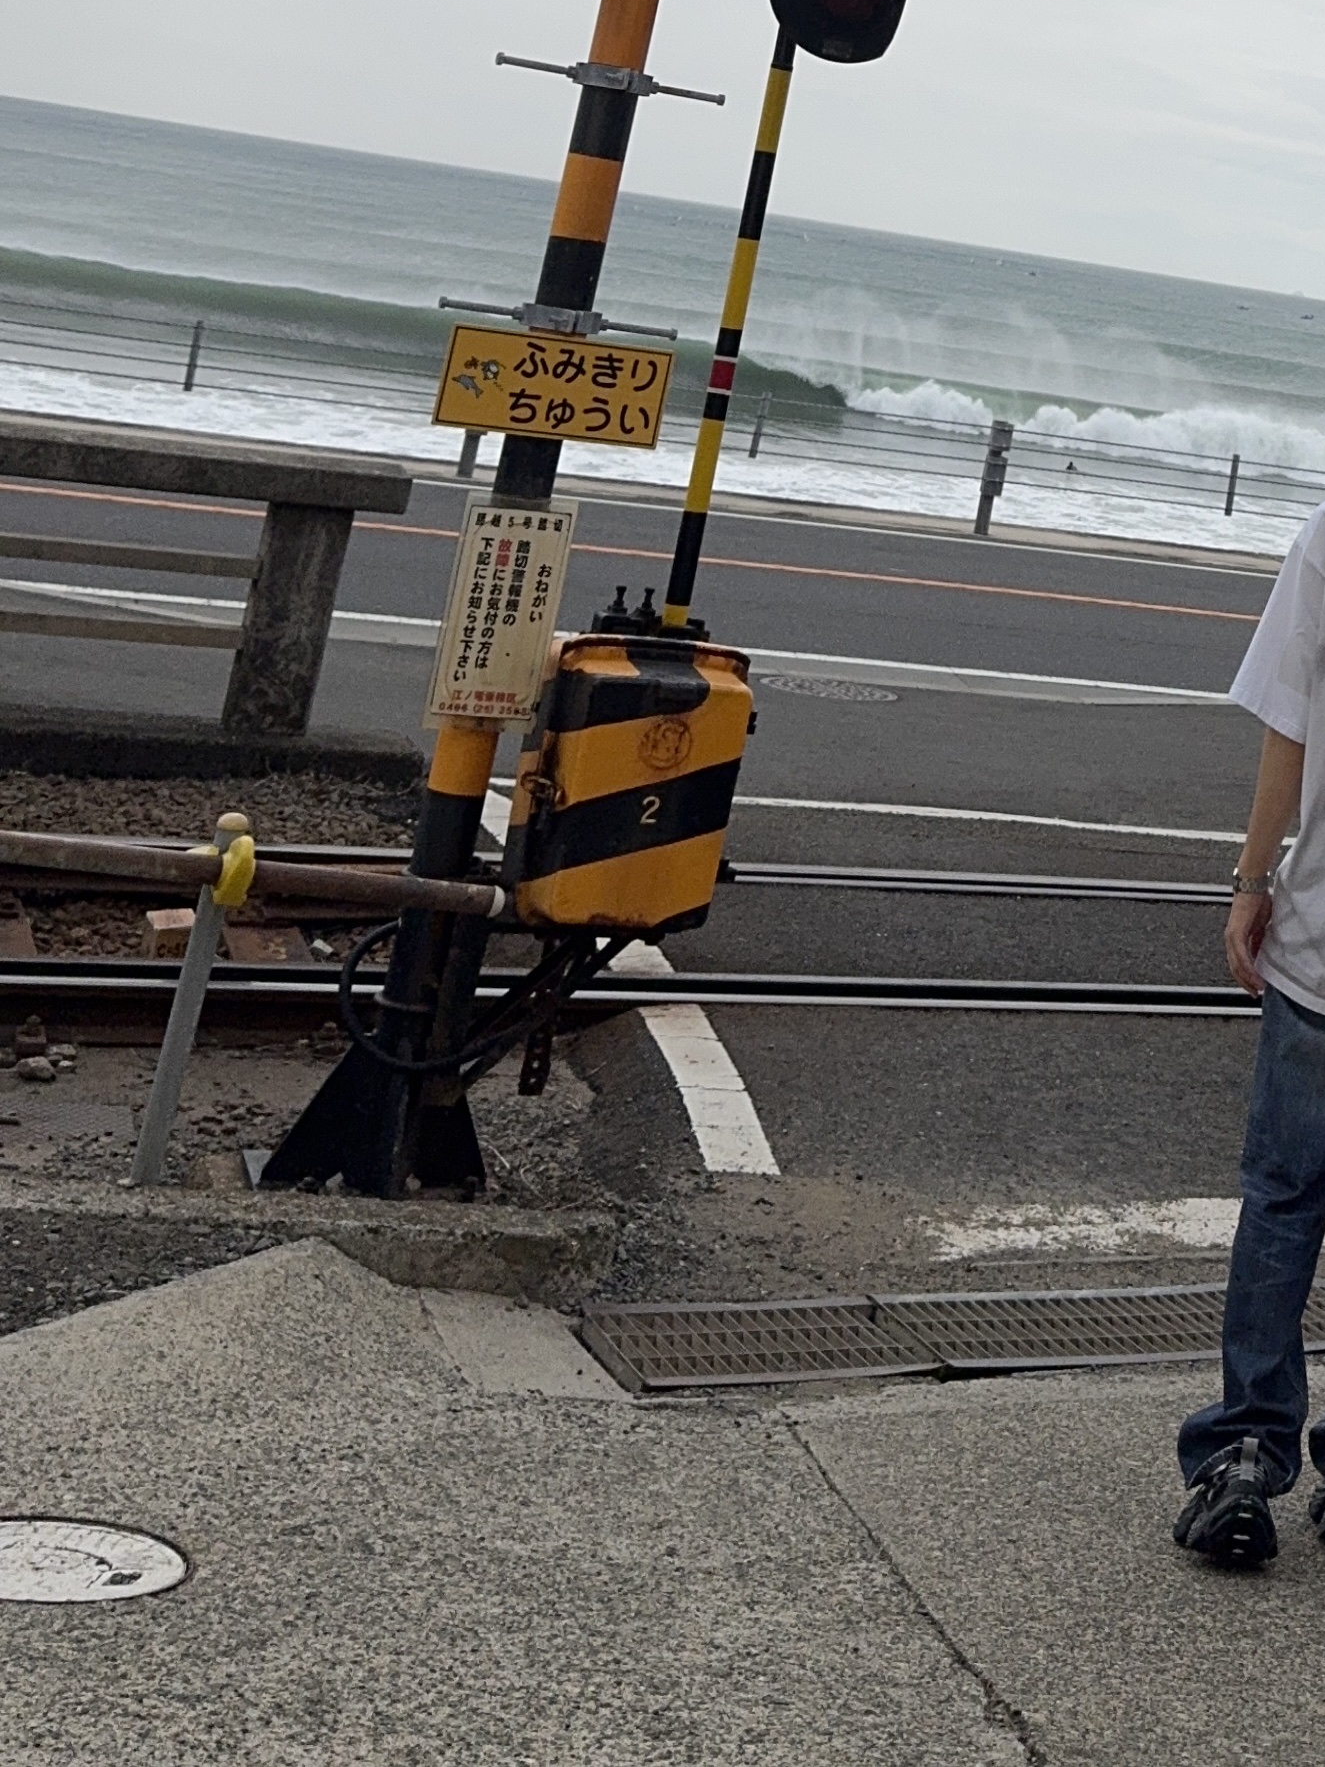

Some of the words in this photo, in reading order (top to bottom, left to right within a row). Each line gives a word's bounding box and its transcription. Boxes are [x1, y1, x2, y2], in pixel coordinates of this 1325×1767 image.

[513, 341, 658, 392] ふみきり
[508, 388, 650, 434] ちゅうい
[453, 537, 495, 682] 下記にお知らせ下さい
[474, 538, 513, 670] 故障にお気付の方は
[502, 539, 532, 626] 踏切警報機の
[529, 564, 552, 623] おねがい
[639, 796, 661, 824] 2
